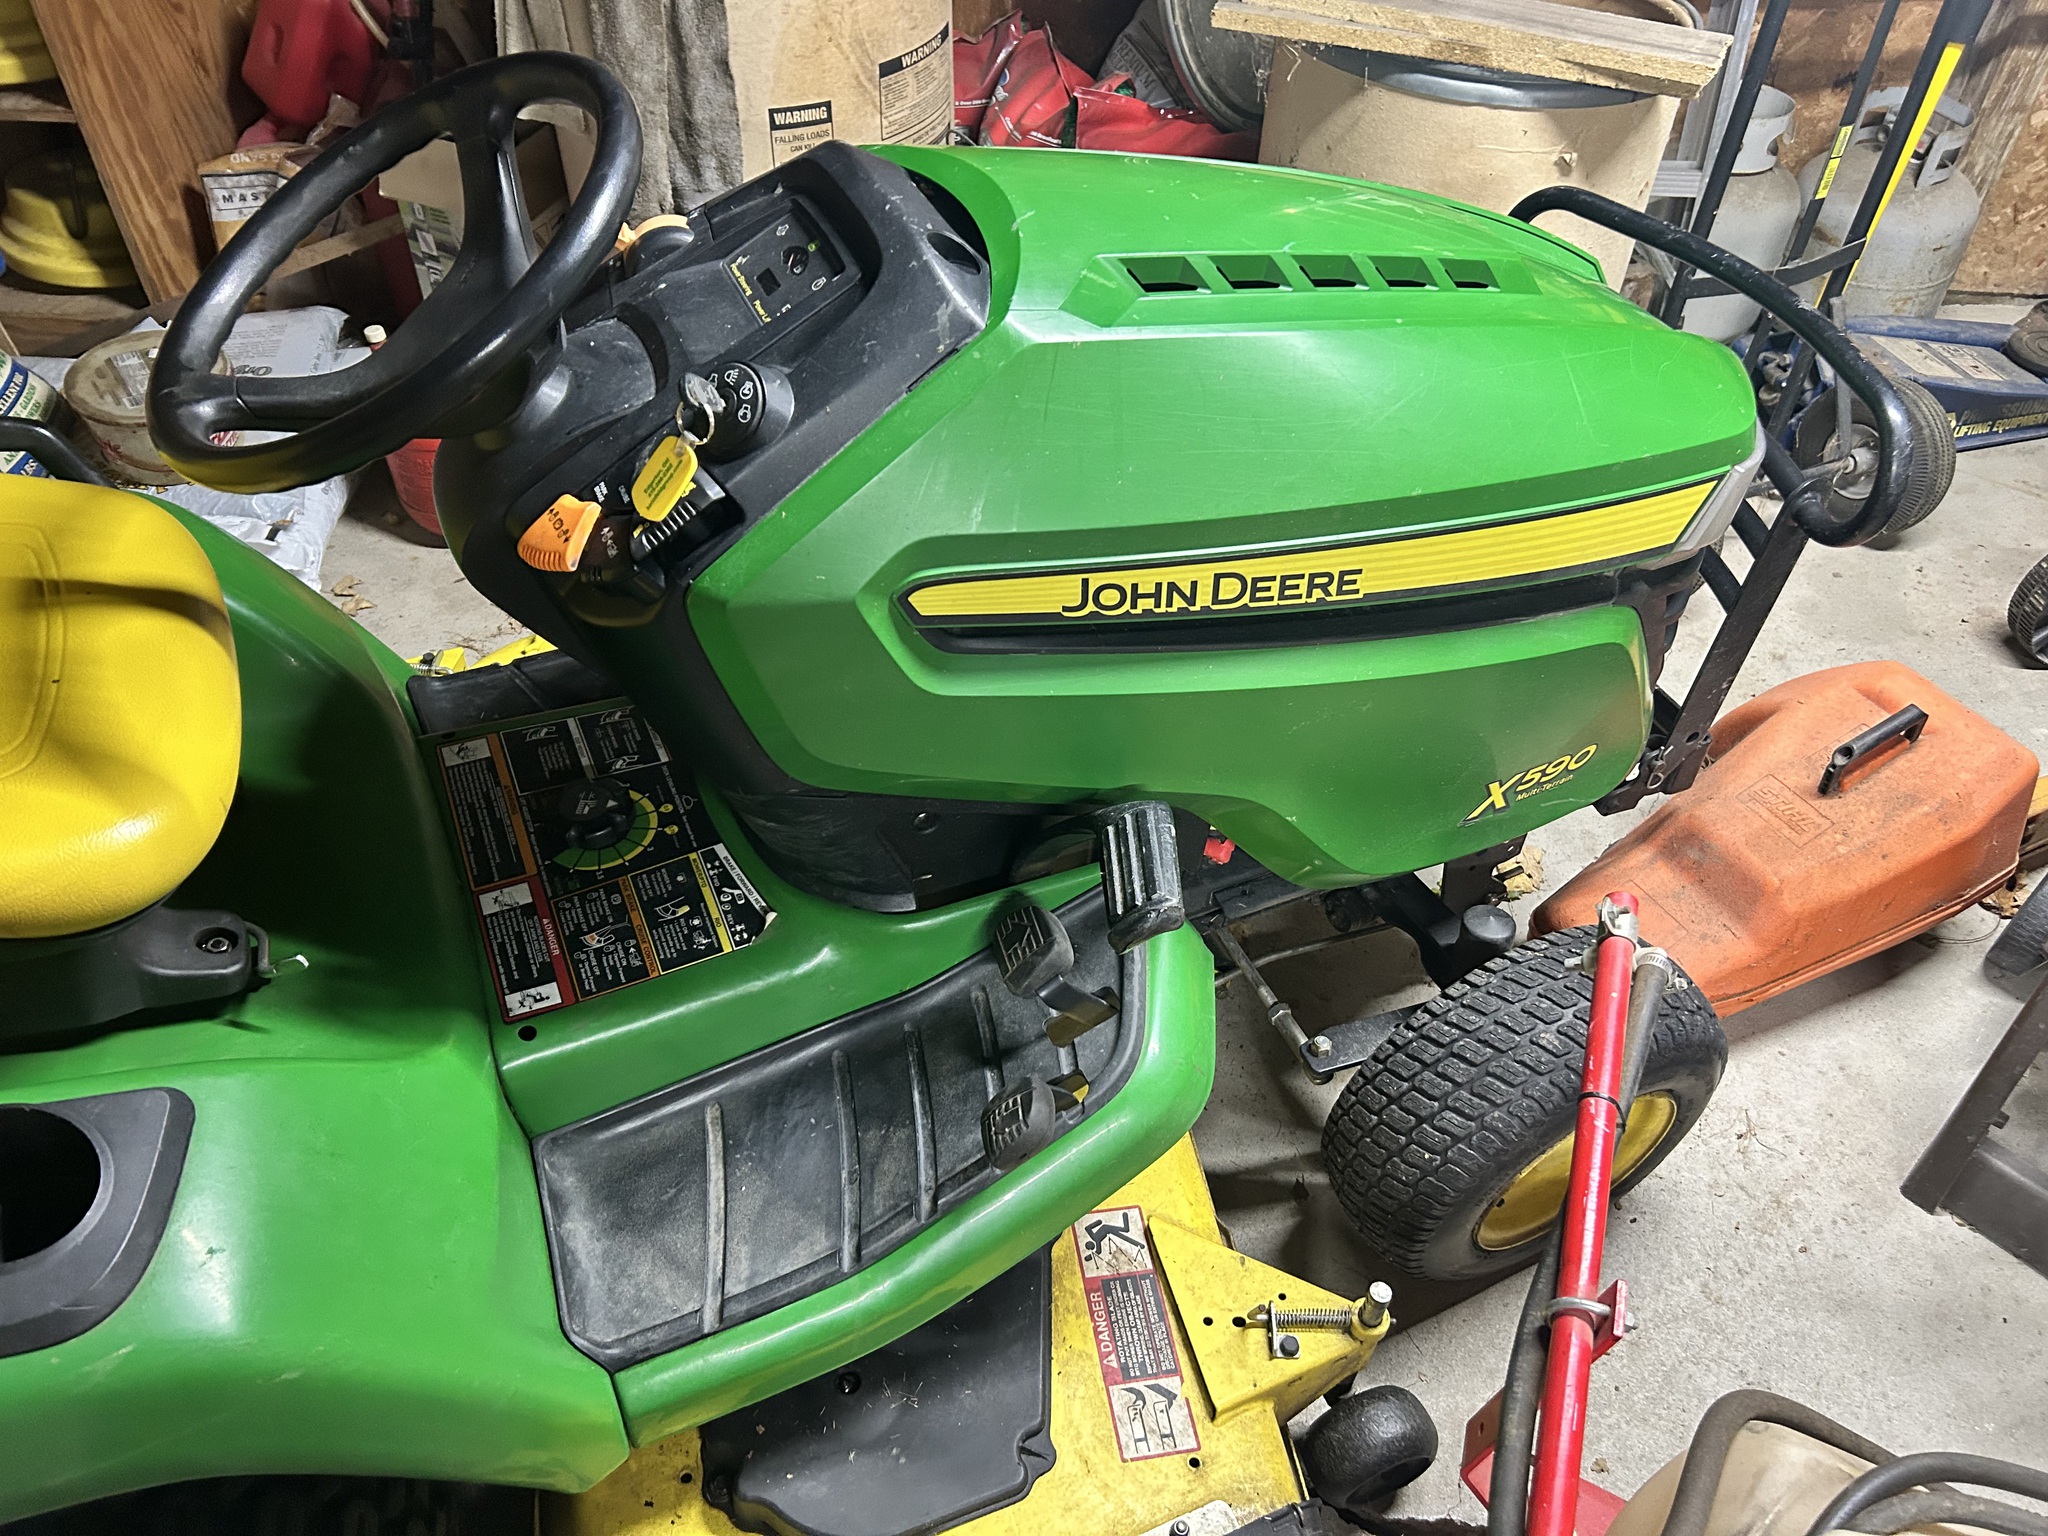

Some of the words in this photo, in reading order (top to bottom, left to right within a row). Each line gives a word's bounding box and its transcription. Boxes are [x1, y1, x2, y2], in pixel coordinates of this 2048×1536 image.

[899, 33, 944, 68] WARNING
[772, 105, 828, 125] WARNING
[774, 132, 805, 144] FALLING
[806, 128, 830, 139] LOADS
[789, 144, 803, 152] CAN
[1952, 420, 1993, 438] LIFTING
[1059, 569, 1200, 614] JOHN
[1208, 567, 1365, 605] DEERE
[1464, 743, 1596, 820] X590
[721, 854, 737, 872] BRAKE
[734, 872, 754, 896] FORWARD
[543, 922, 560, 956] DANGER
[1089, 1290, 1113, 1353] DANGER
[1106, 1294, 1117, 1322] BLADE
[1122, 1290, 1136, 1327] OBJECTS
[1111, 1321, 1126, 1363] ROTATING
[1130, 1327, 1144, 1363] THROWN
